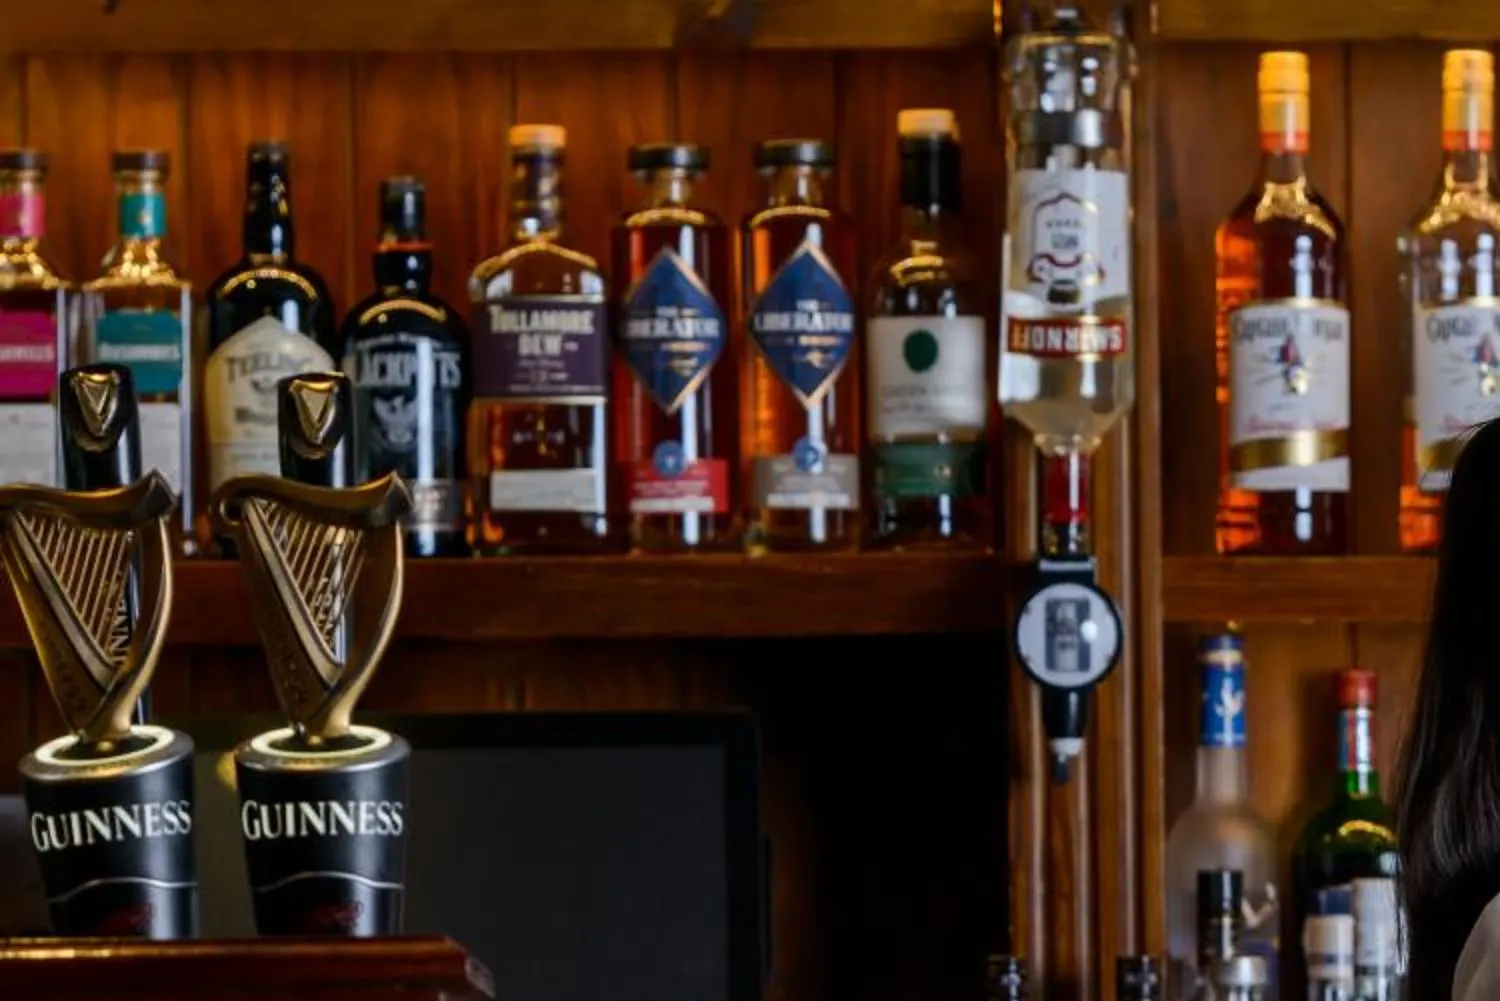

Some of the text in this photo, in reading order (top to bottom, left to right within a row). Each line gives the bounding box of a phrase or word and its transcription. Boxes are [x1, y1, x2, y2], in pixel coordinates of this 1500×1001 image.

[622, 317, 720, 338] IBERATOR
[31, 800, 193, 853] GUINNESS
[241, 799, 404, 841] GUINNESS
